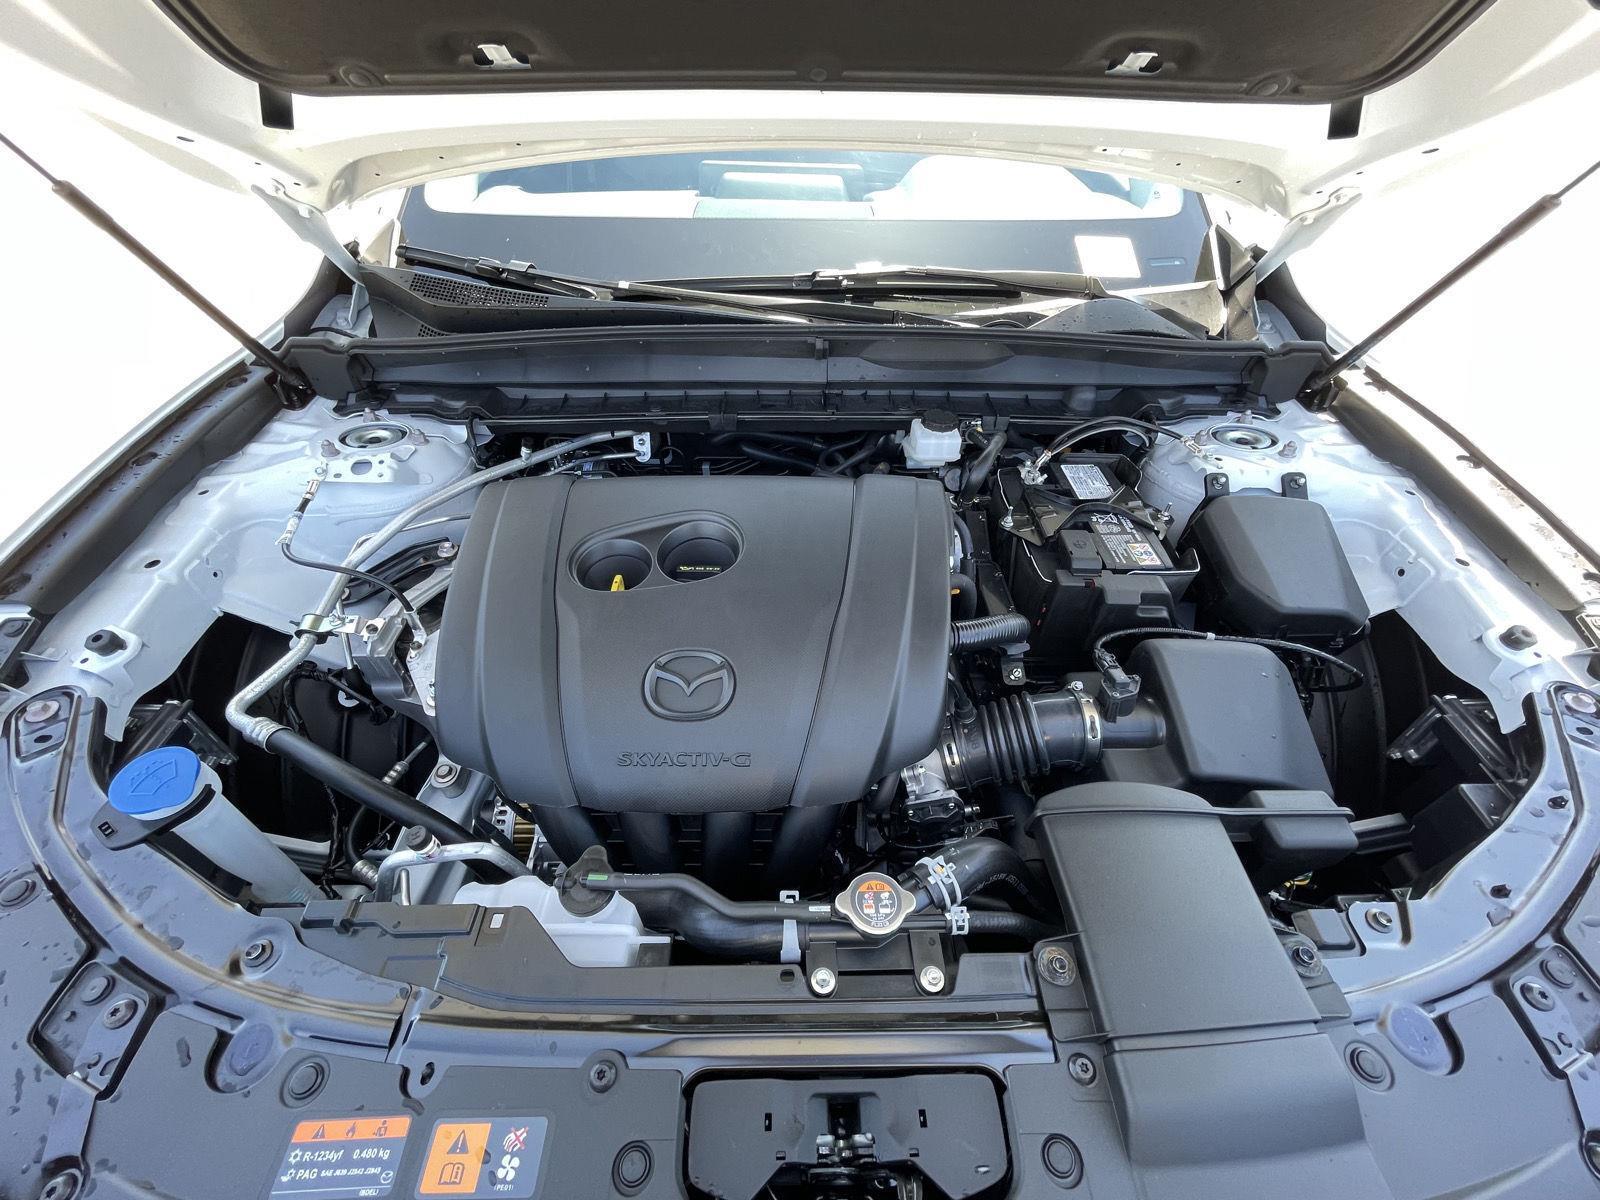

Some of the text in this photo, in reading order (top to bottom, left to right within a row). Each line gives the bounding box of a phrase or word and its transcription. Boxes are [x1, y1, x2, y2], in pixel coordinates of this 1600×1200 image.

[616, 751, 752, 767] SKYACTIV-G
[302, 1147, 391, 1162] R-1234yf 0.480 kg
[295, 1168, 318, 1180] PAG
